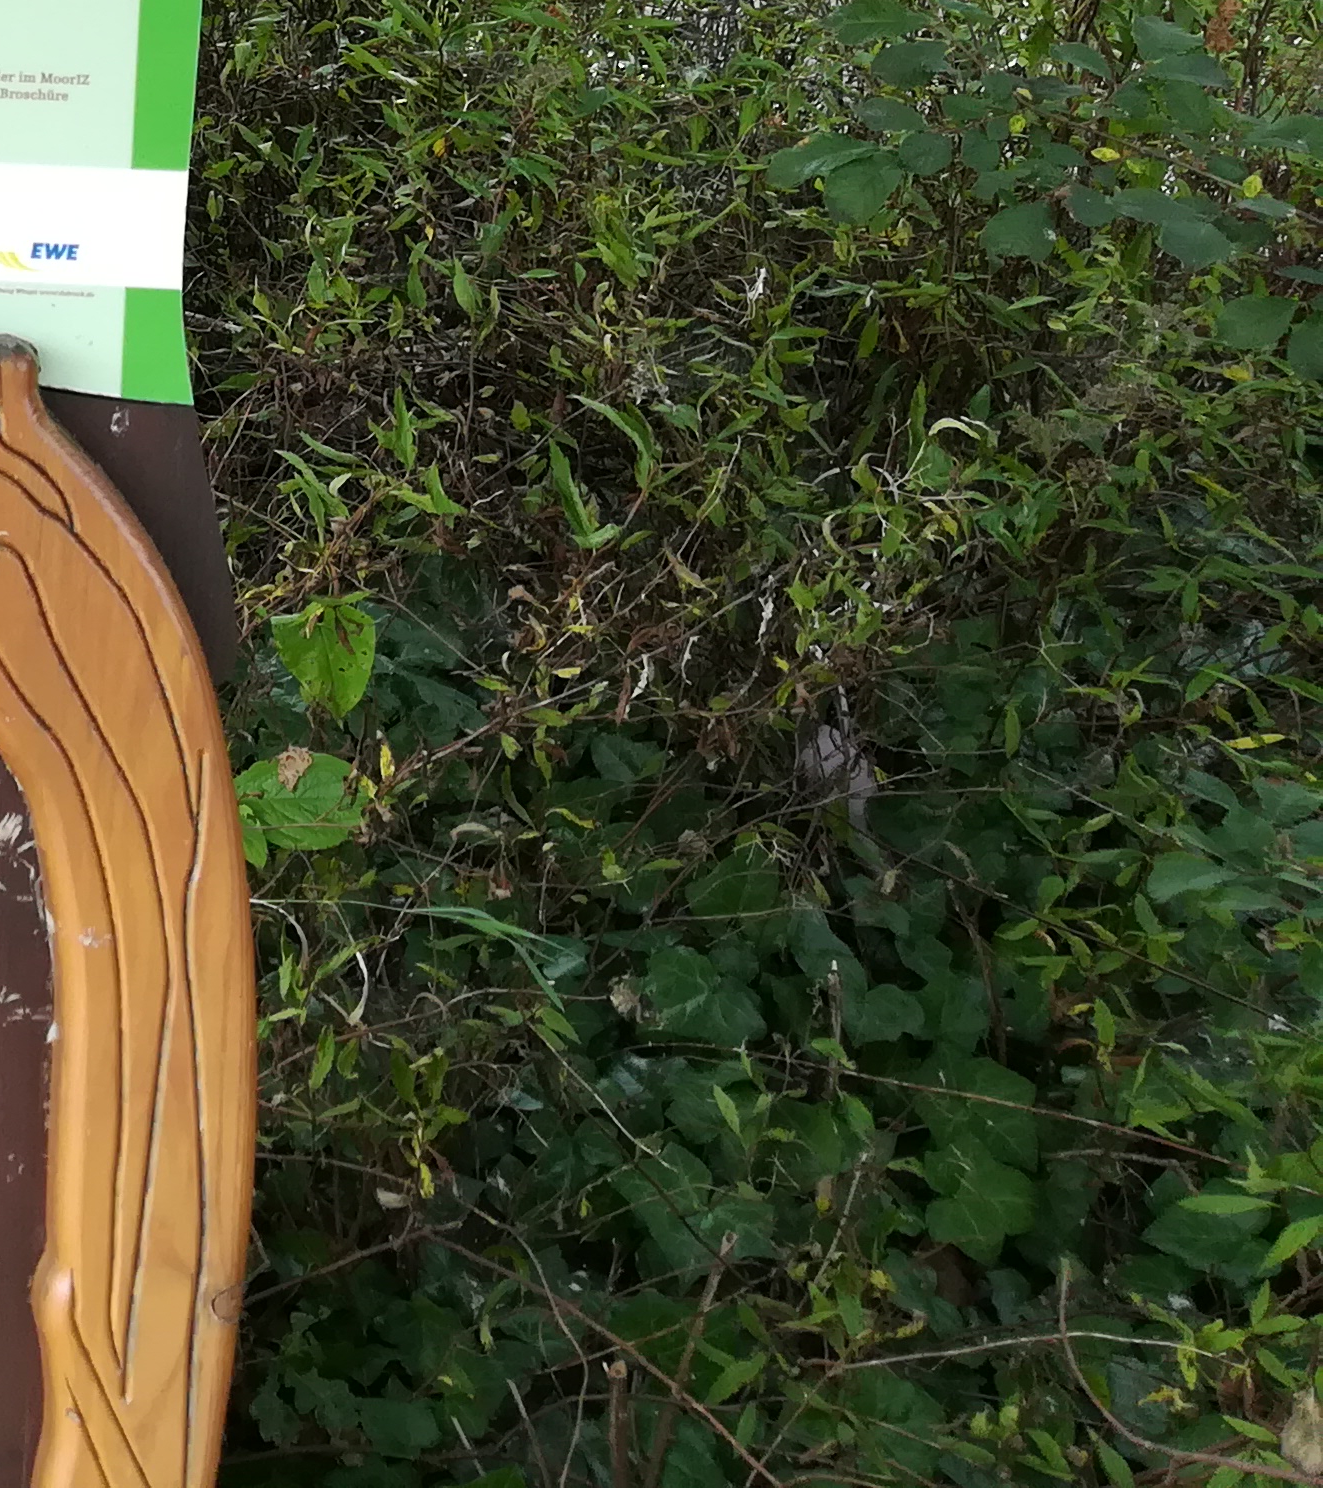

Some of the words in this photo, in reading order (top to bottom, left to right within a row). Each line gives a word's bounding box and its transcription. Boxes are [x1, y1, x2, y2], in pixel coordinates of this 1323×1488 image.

[18, 72, 36, 83] im
[0, 88, 69, 101] Broschüre
[30, 242, 80, 261] EWE
